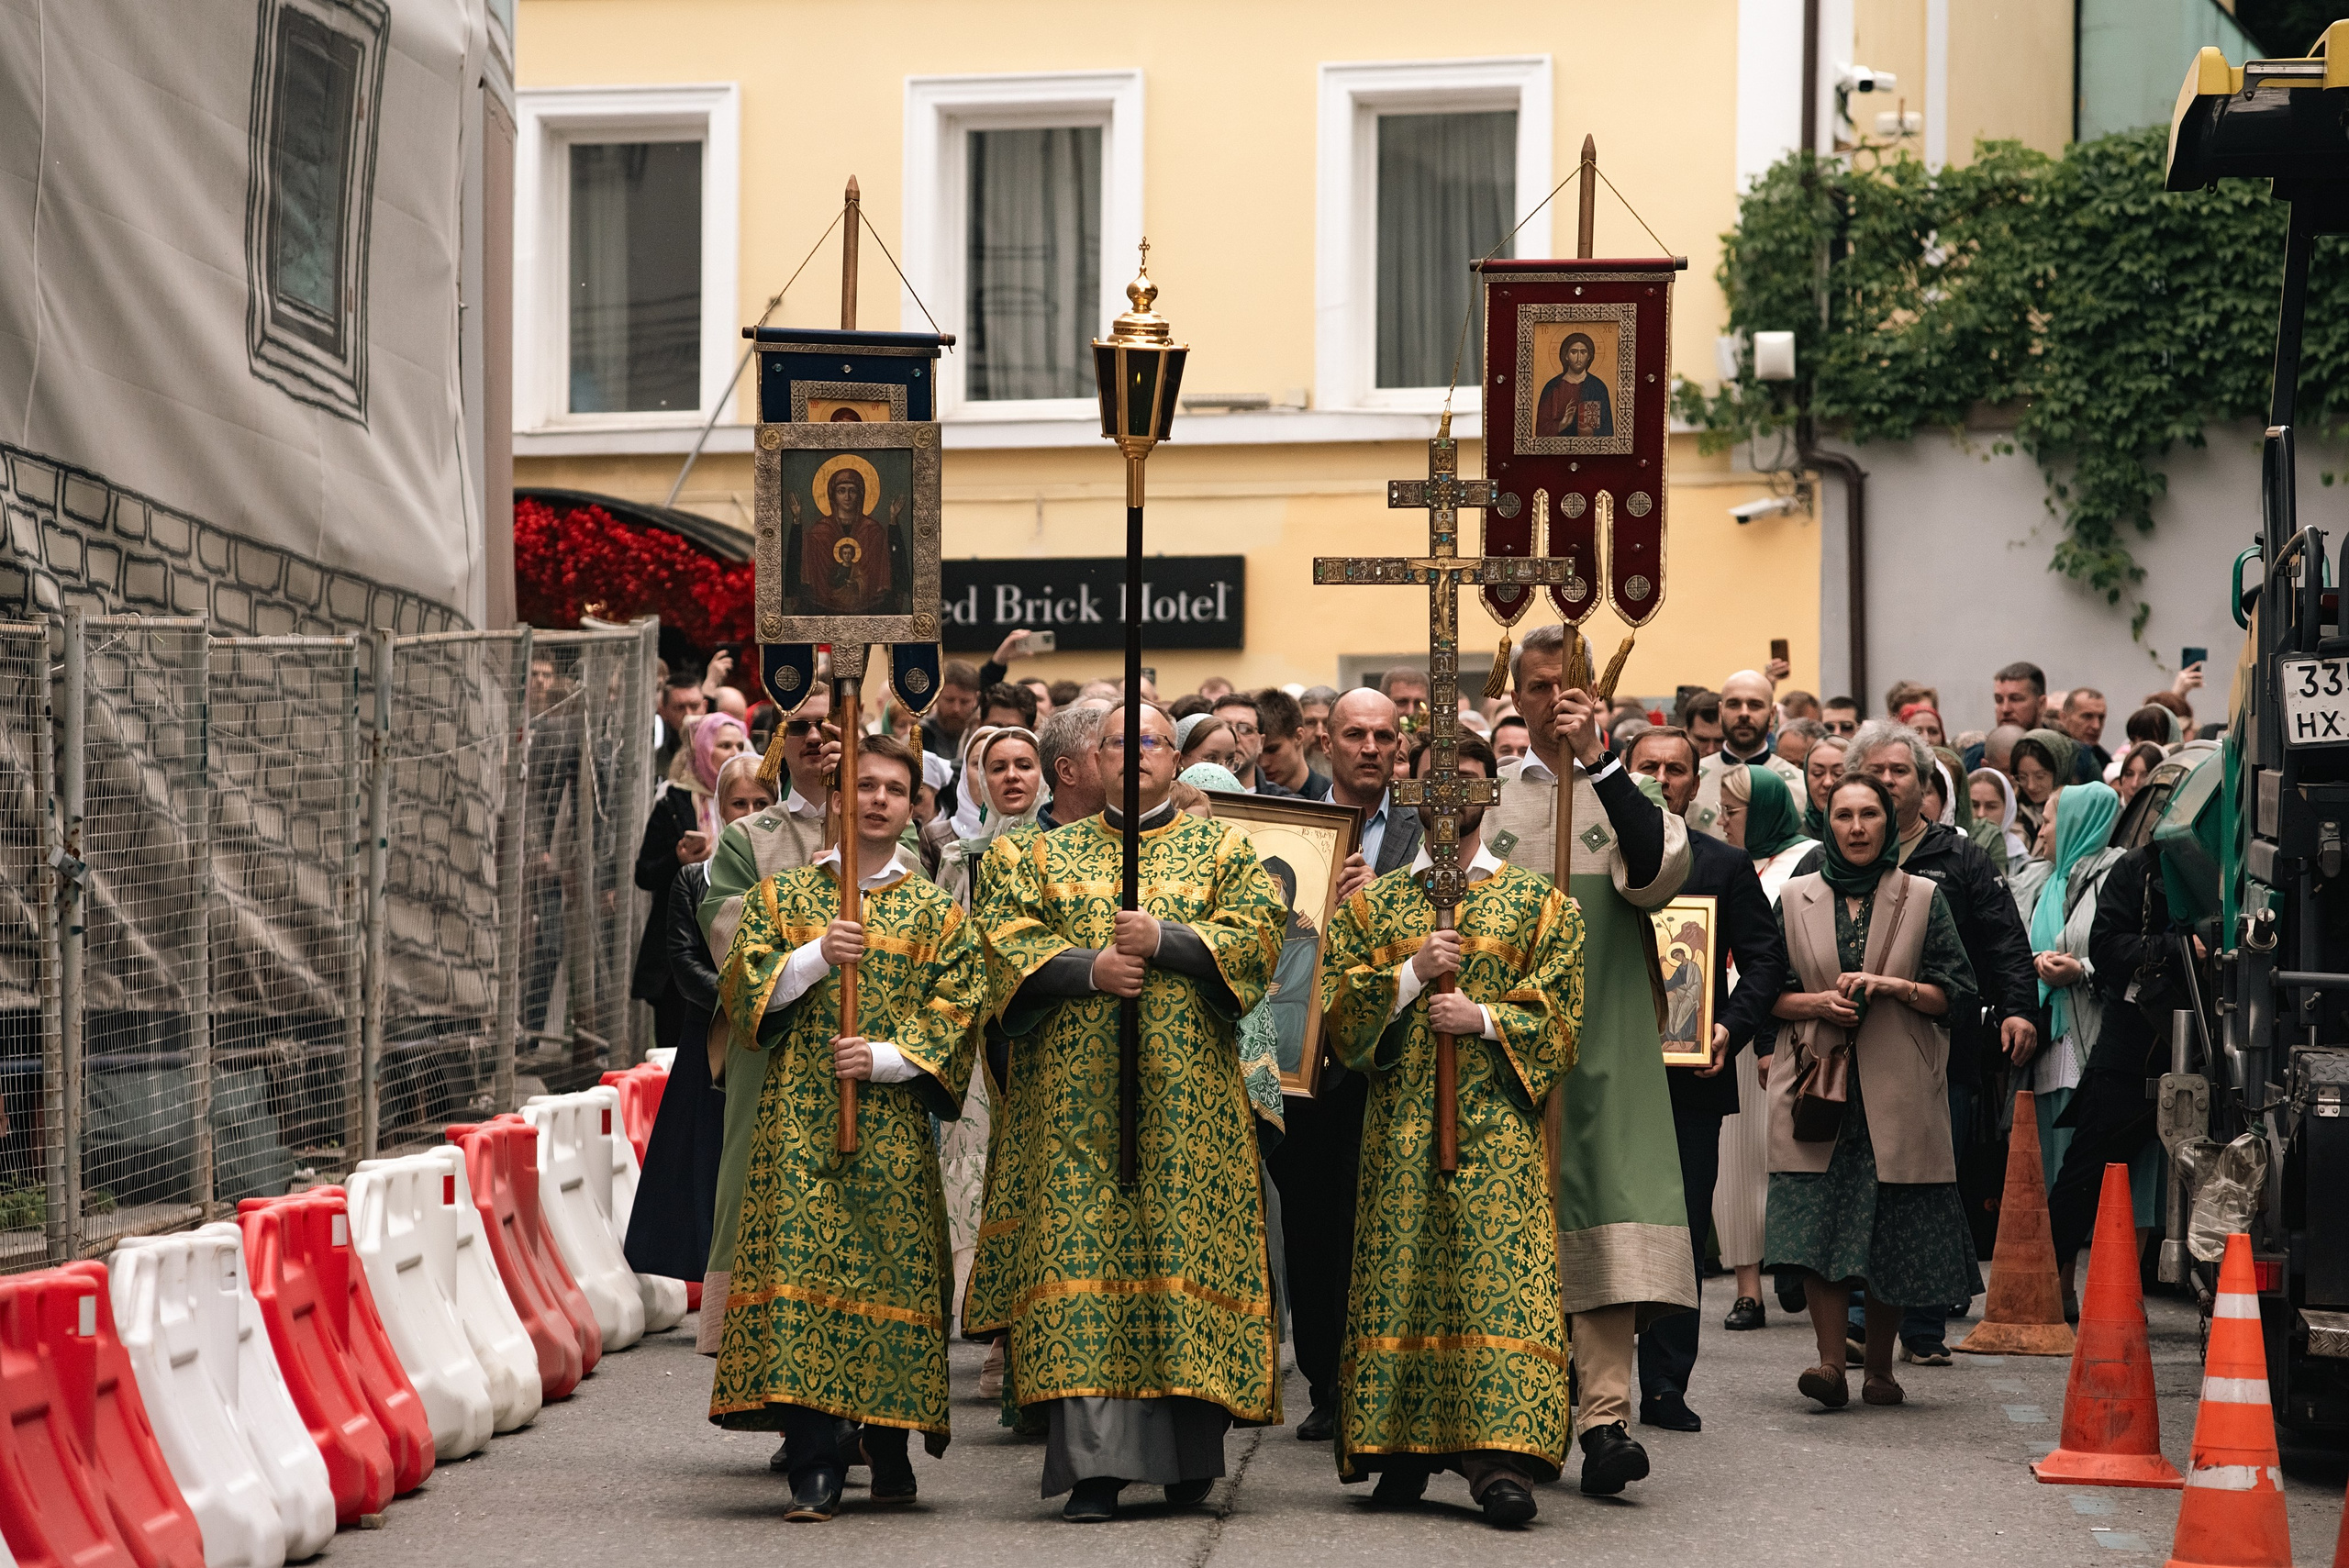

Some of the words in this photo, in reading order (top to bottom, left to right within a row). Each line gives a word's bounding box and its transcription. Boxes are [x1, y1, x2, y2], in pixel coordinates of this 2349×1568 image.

[941, 584, 978, 626] ed
[994, 584, 1102, 625] Brick
[1118, 582, 1228, 624] Hotel
[2298, 663, 2349, 698] 33
